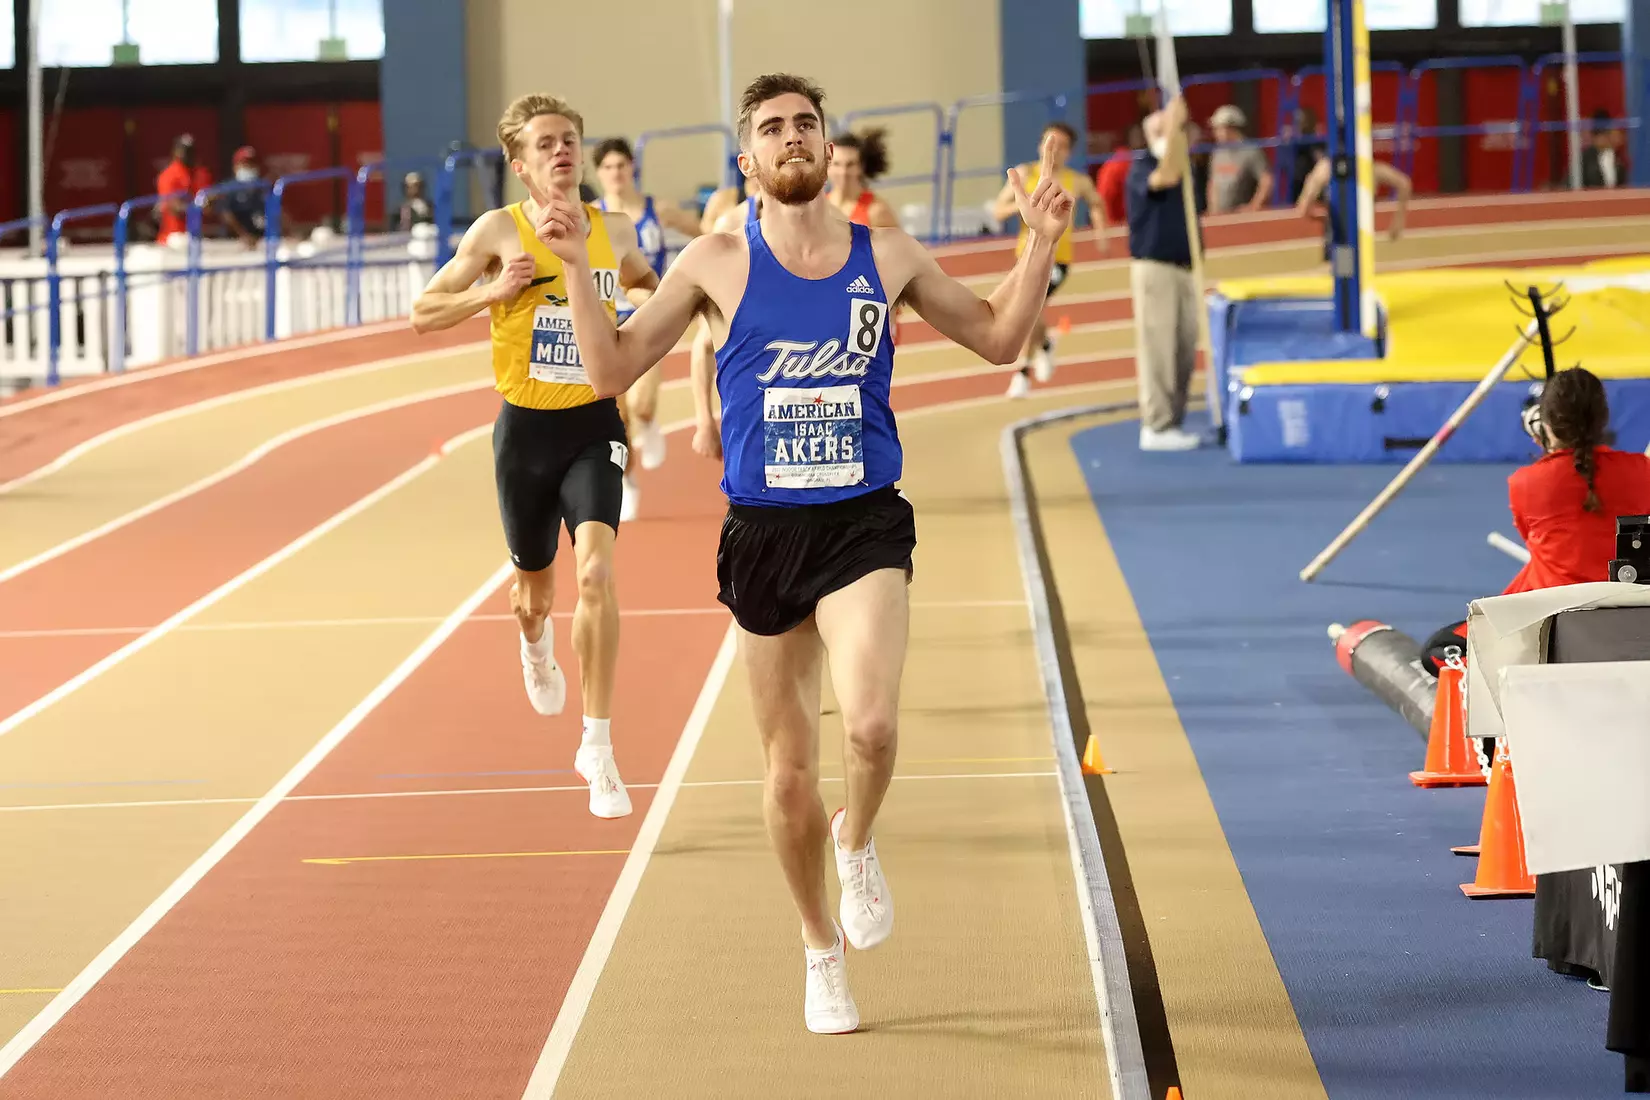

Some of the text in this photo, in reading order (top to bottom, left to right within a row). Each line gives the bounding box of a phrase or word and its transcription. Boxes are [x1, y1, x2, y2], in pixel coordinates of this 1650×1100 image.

[593, 271, 614, 299] 10
[846, 285, 875, 295] adidas
[857, 303, 880, 353] 8
[536, 342, 583, 365] MOO
[755, 338, 871, 383] Tulsa
[768, 402, 856, 419] AMERICAN
[795, 421, 833, 437] ISAAC
[775, 436, 854, 463] AKERS
